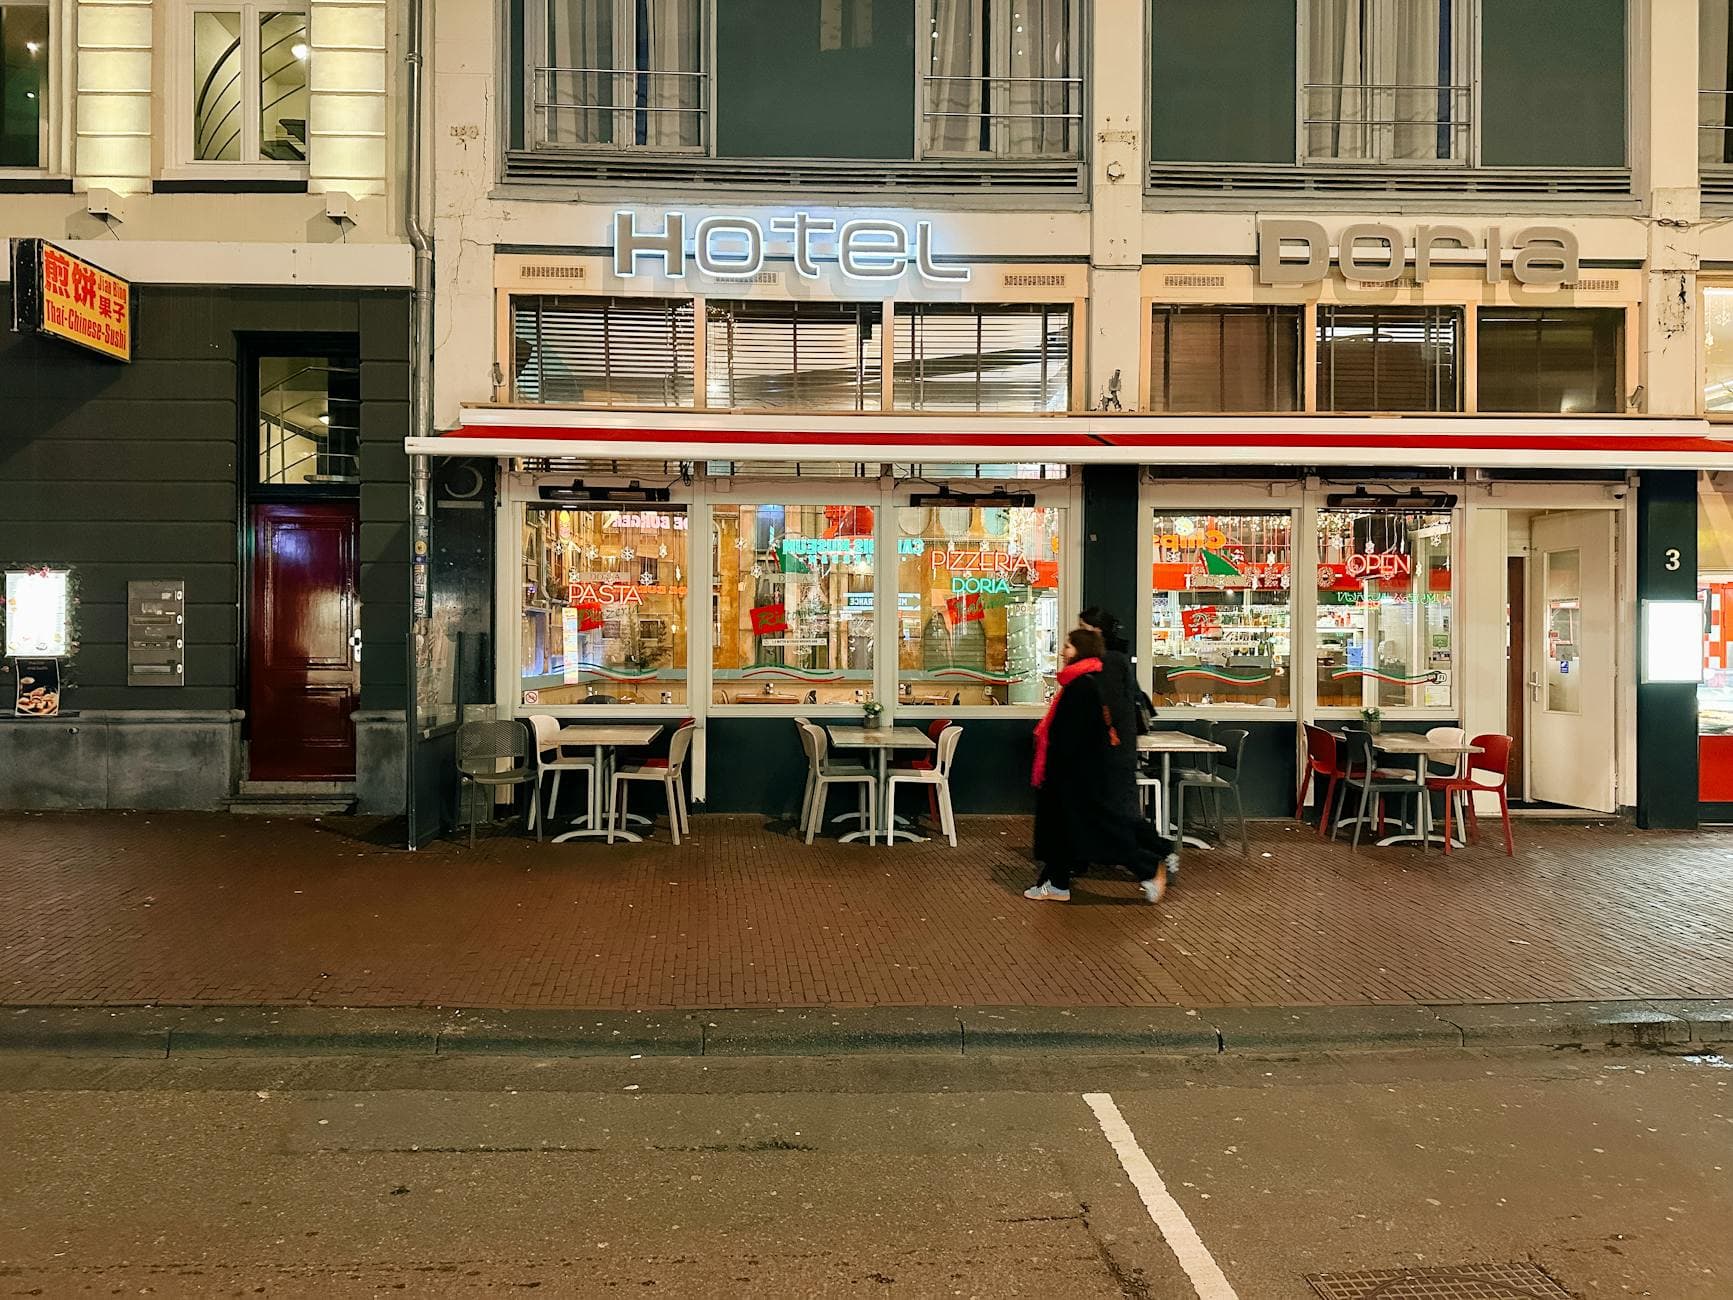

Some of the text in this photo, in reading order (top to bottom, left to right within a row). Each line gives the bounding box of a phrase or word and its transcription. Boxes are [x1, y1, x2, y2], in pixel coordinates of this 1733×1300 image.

[1259, 219, 1579, 284] Doria
[931, 550, 1031, 571] PIZZERIA
[1347, 554, 1411, 575] OPEN
[1665, 548, 1681, 571] 3
[568, 583, 644, 606] PASTA
[952, 577, 1011, 594] DORIA
